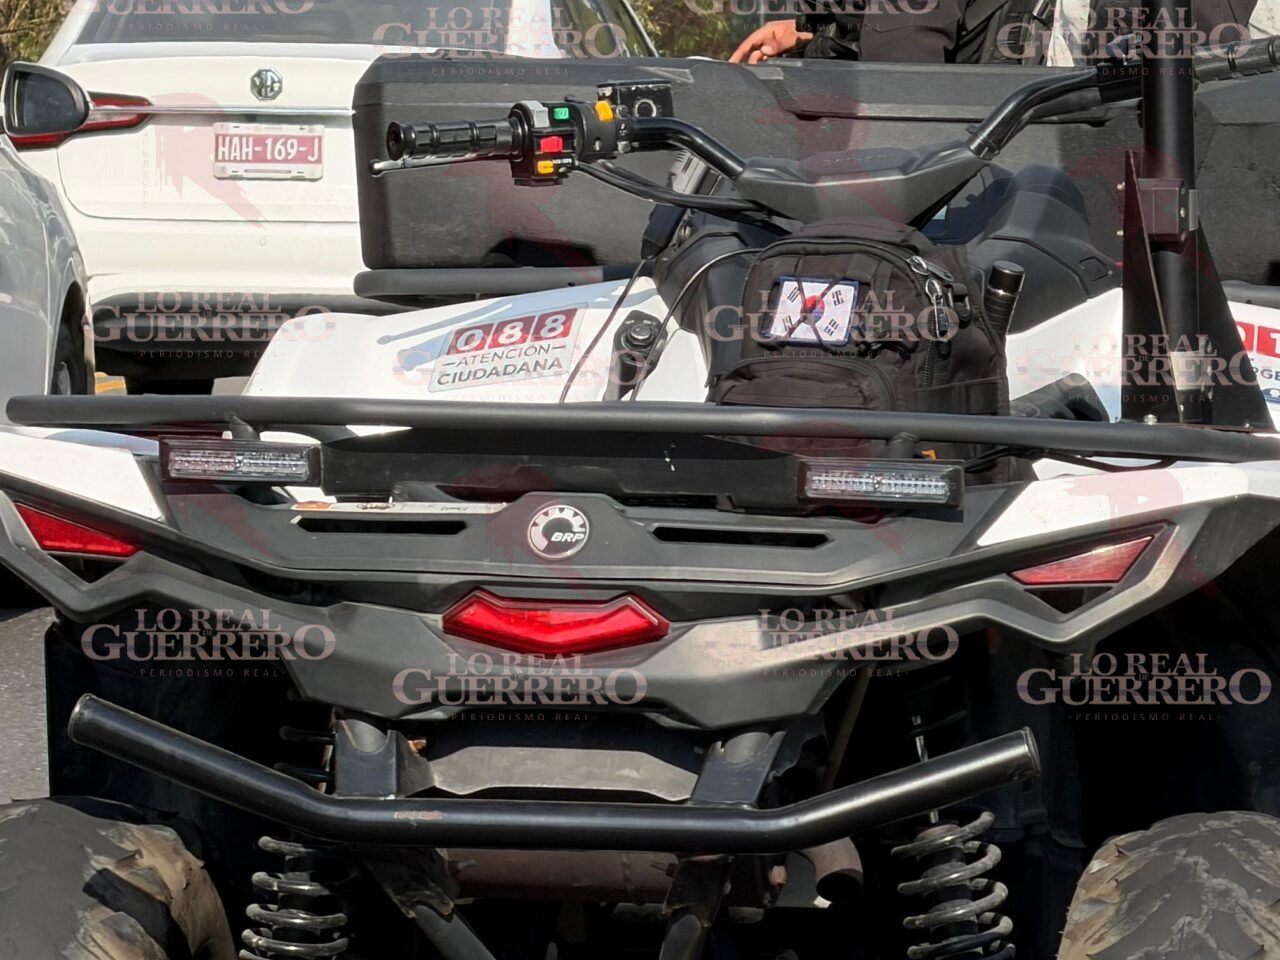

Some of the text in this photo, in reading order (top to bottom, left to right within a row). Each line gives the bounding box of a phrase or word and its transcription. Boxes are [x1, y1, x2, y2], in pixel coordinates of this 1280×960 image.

[217, 135, 319, 162] HAH-169-J
[456, 313, 566, 351] 088
[456, 342, 550, 368] ATENCIÓN
[437, 357, 563, 386] CIUDADANA
[550, 531, 585, 543] BRP
